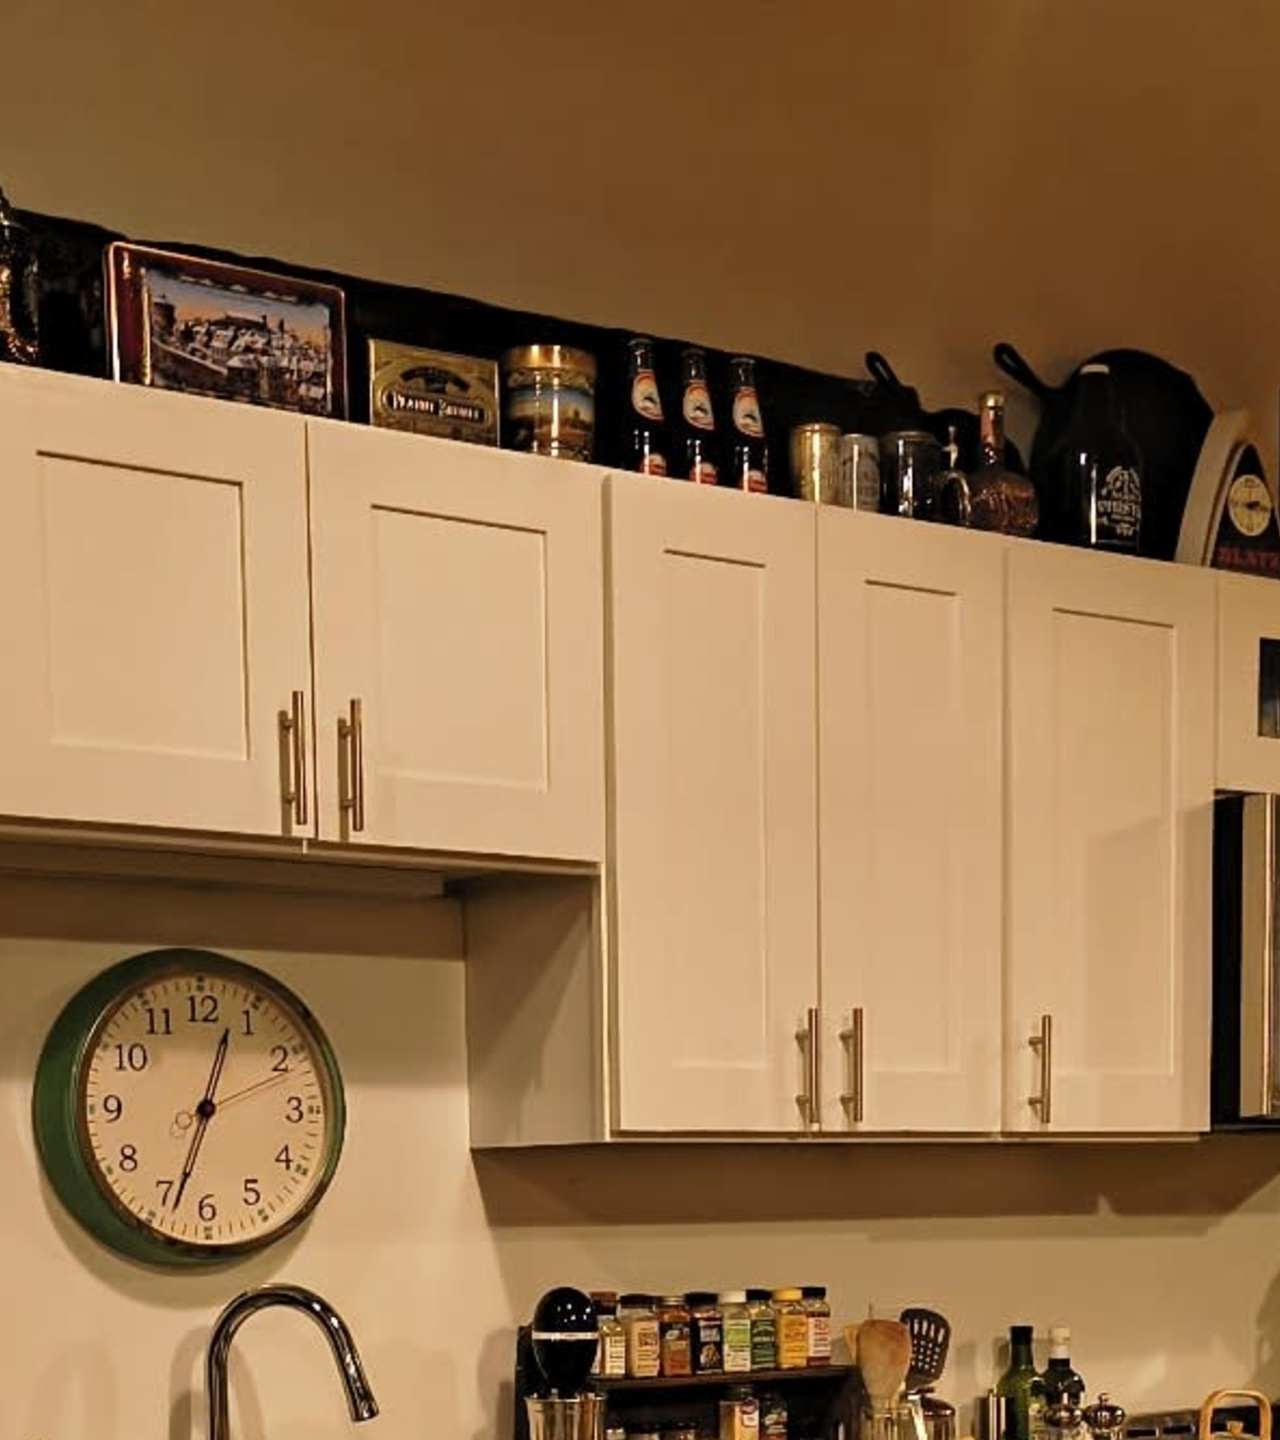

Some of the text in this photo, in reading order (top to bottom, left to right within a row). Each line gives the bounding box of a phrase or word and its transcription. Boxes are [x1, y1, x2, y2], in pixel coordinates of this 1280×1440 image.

[145, 1007, 173, 1036] 11
[186, 995, 220, 1023] 12
[241, 1010, 255, 1036] 1
[114, 1043, 148, 1072] 10
[270, 1045, 289, 1072] 2
[103, 1095, 123, 1123] 9
[285, 1096, 304, 1123] 3
[118, 1144, 138, 1171] 8
[274, 1144, 294, 1171] 4
[155, 1180, 174, 1207] 7
[242, 1178, 261, 1206] 5
[197, 1193, 217, 1221] 6
